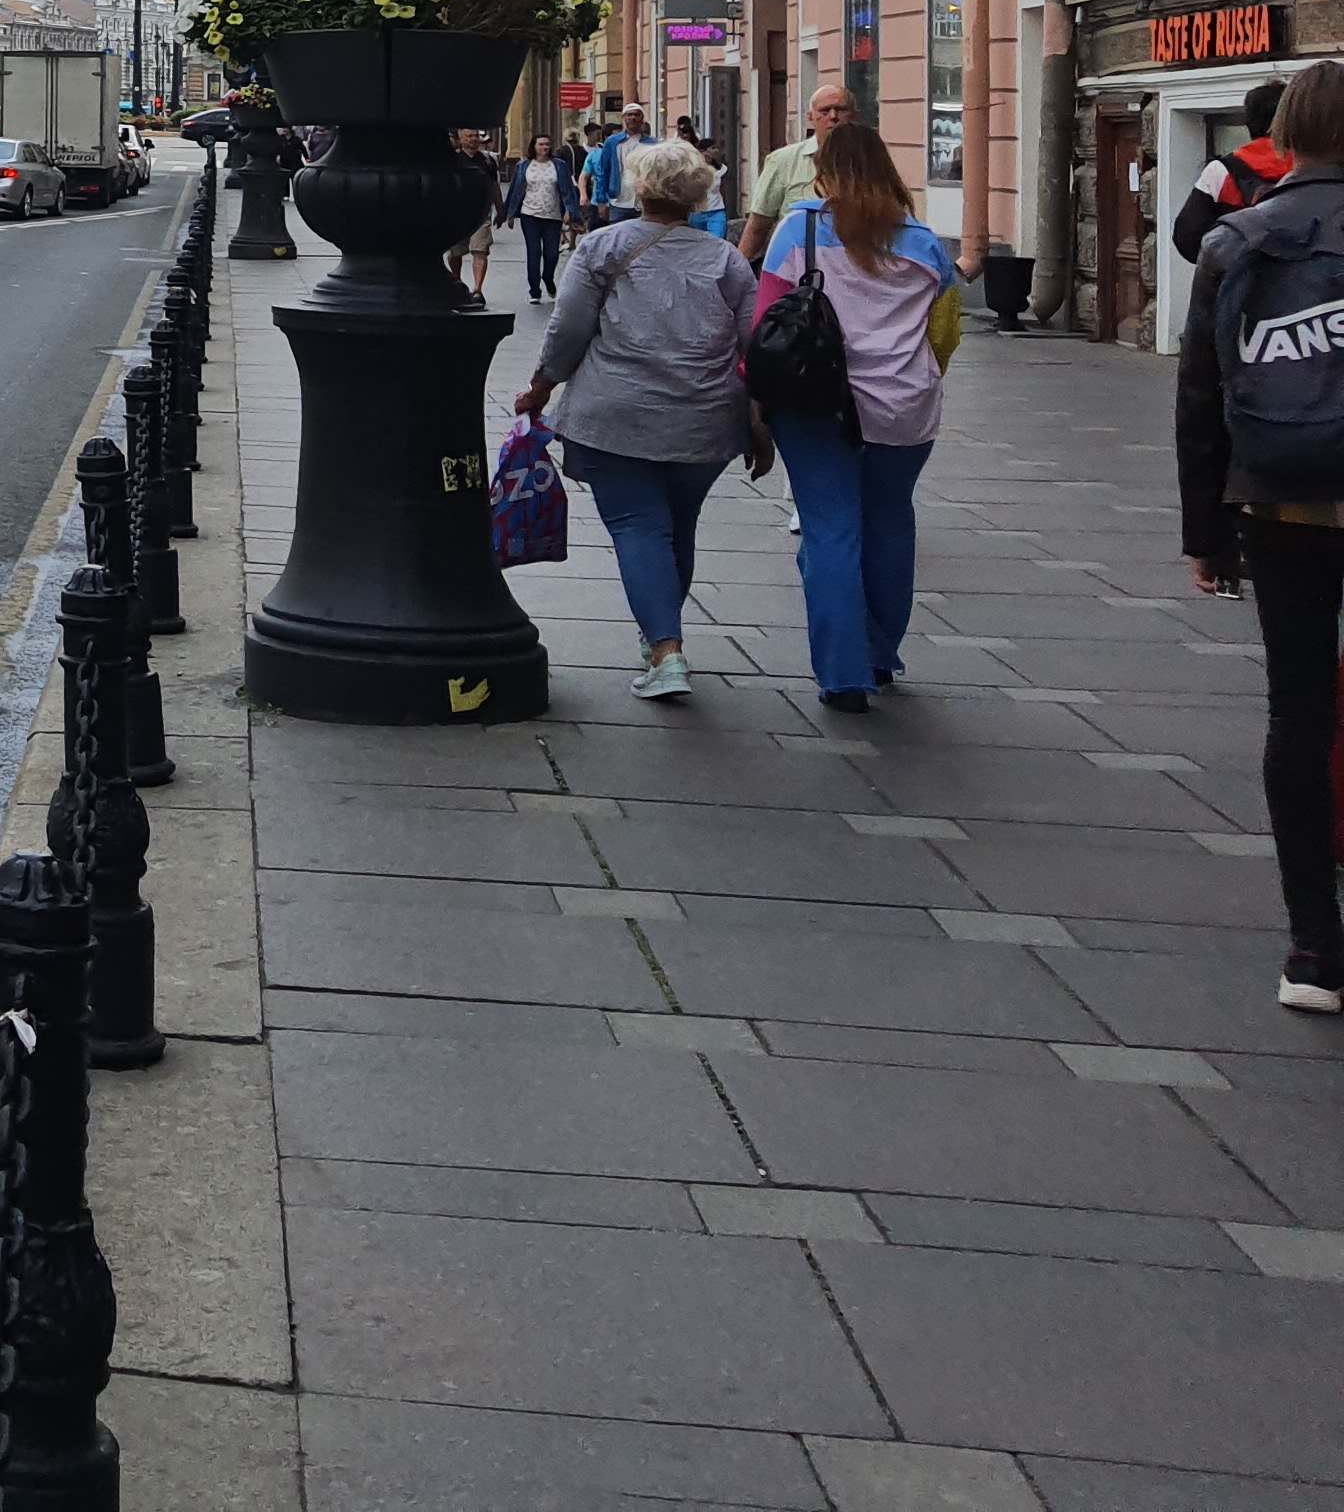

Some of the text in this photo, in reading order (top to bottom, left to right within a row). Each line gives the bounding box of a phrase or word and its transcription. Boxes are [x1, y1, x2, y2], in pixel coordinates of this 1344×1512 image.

[1148, 4, 1270, 63] TASTE OF RUSSIA
